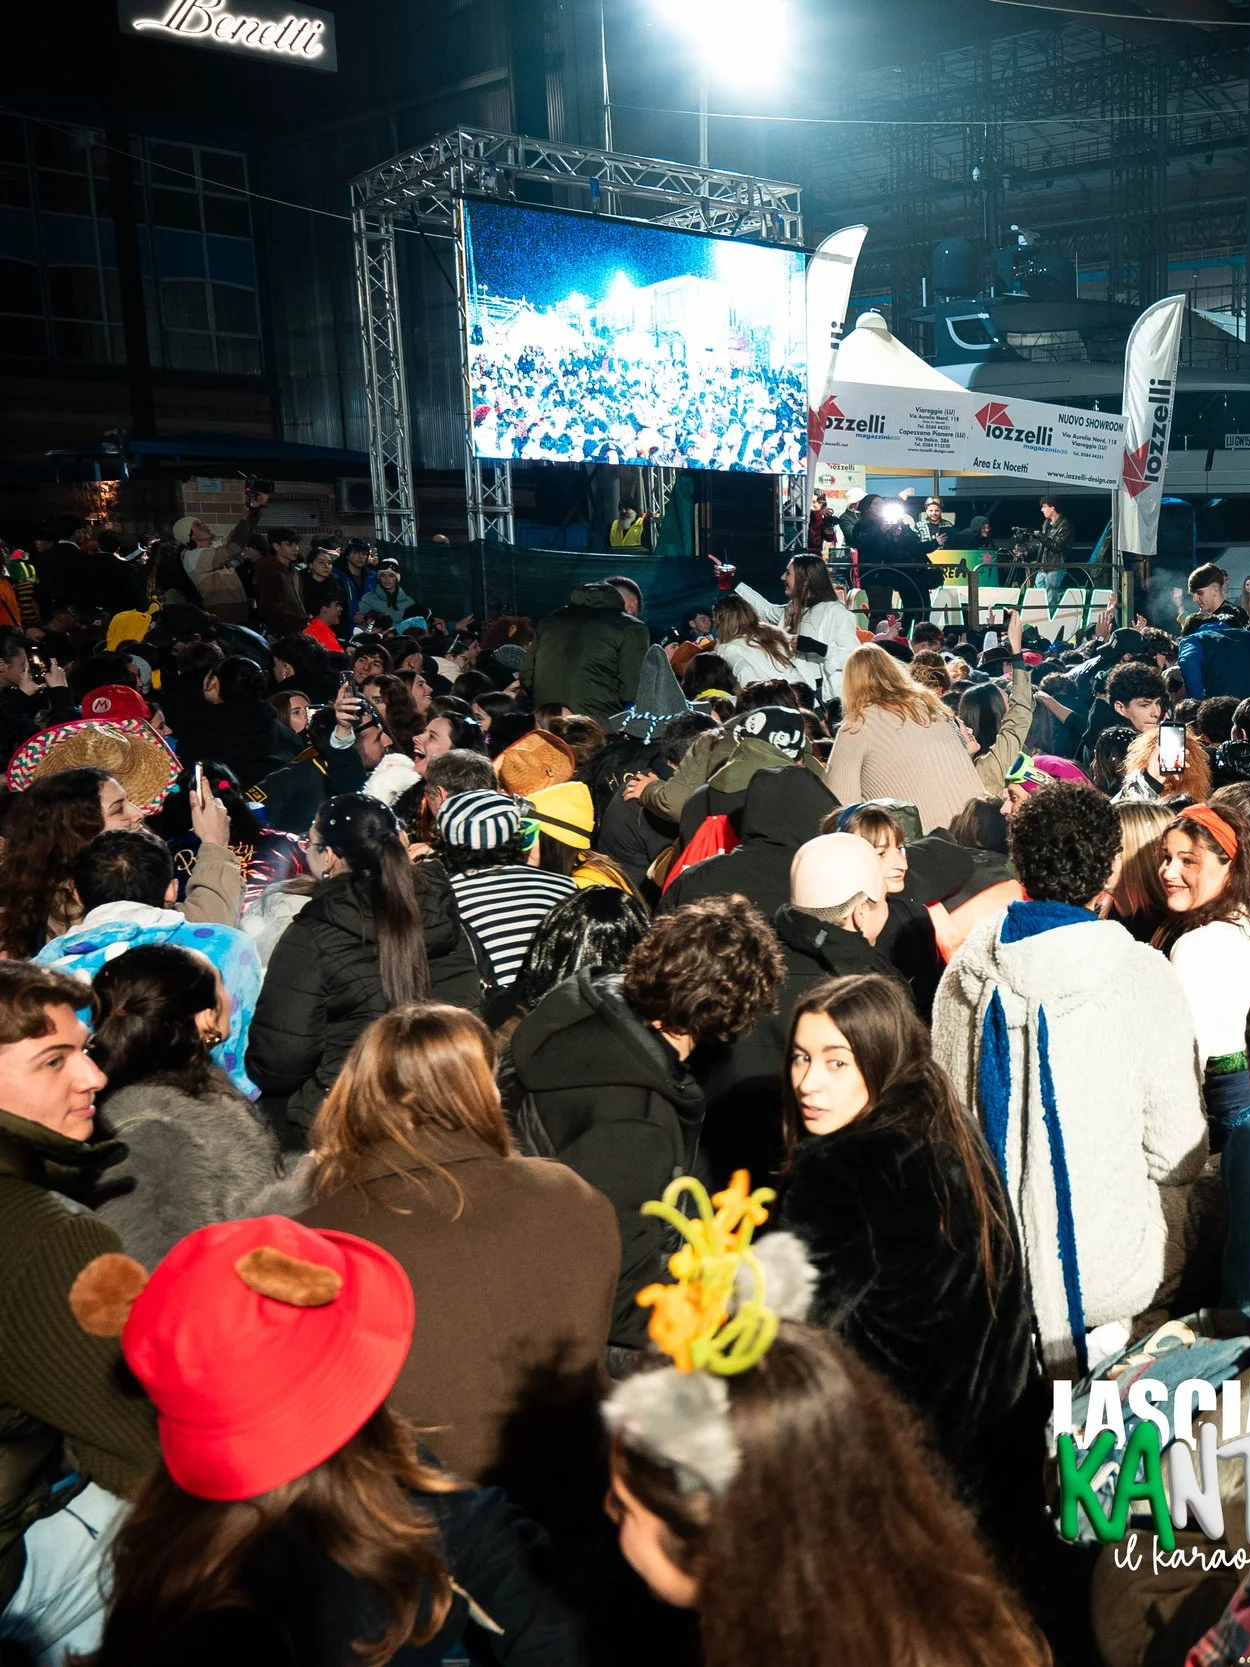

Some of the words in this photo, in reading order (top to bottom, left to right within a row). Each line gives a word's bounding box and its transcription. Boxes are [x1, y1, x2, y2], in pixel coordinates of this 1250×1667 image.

[134, 0, 323, 55] Benetti
[915, 407, 943, 416] Viareggio
[825, 414, 886, 434] ozzelli
[1058, 413, 1084, 427] NUOVO
[1085, 417, 1123, 432] SHOWROOM
[1072, 433, 1091, 441] Aurelia
[1071, 440, 1097, 450] Viareggio
[1097, 444, 1108, 452] (LU)
[973, 457, 991, 469] Area
[992, 459, 1001, 470] Ex
[1003, 460, 1029, 473] Nocetti
